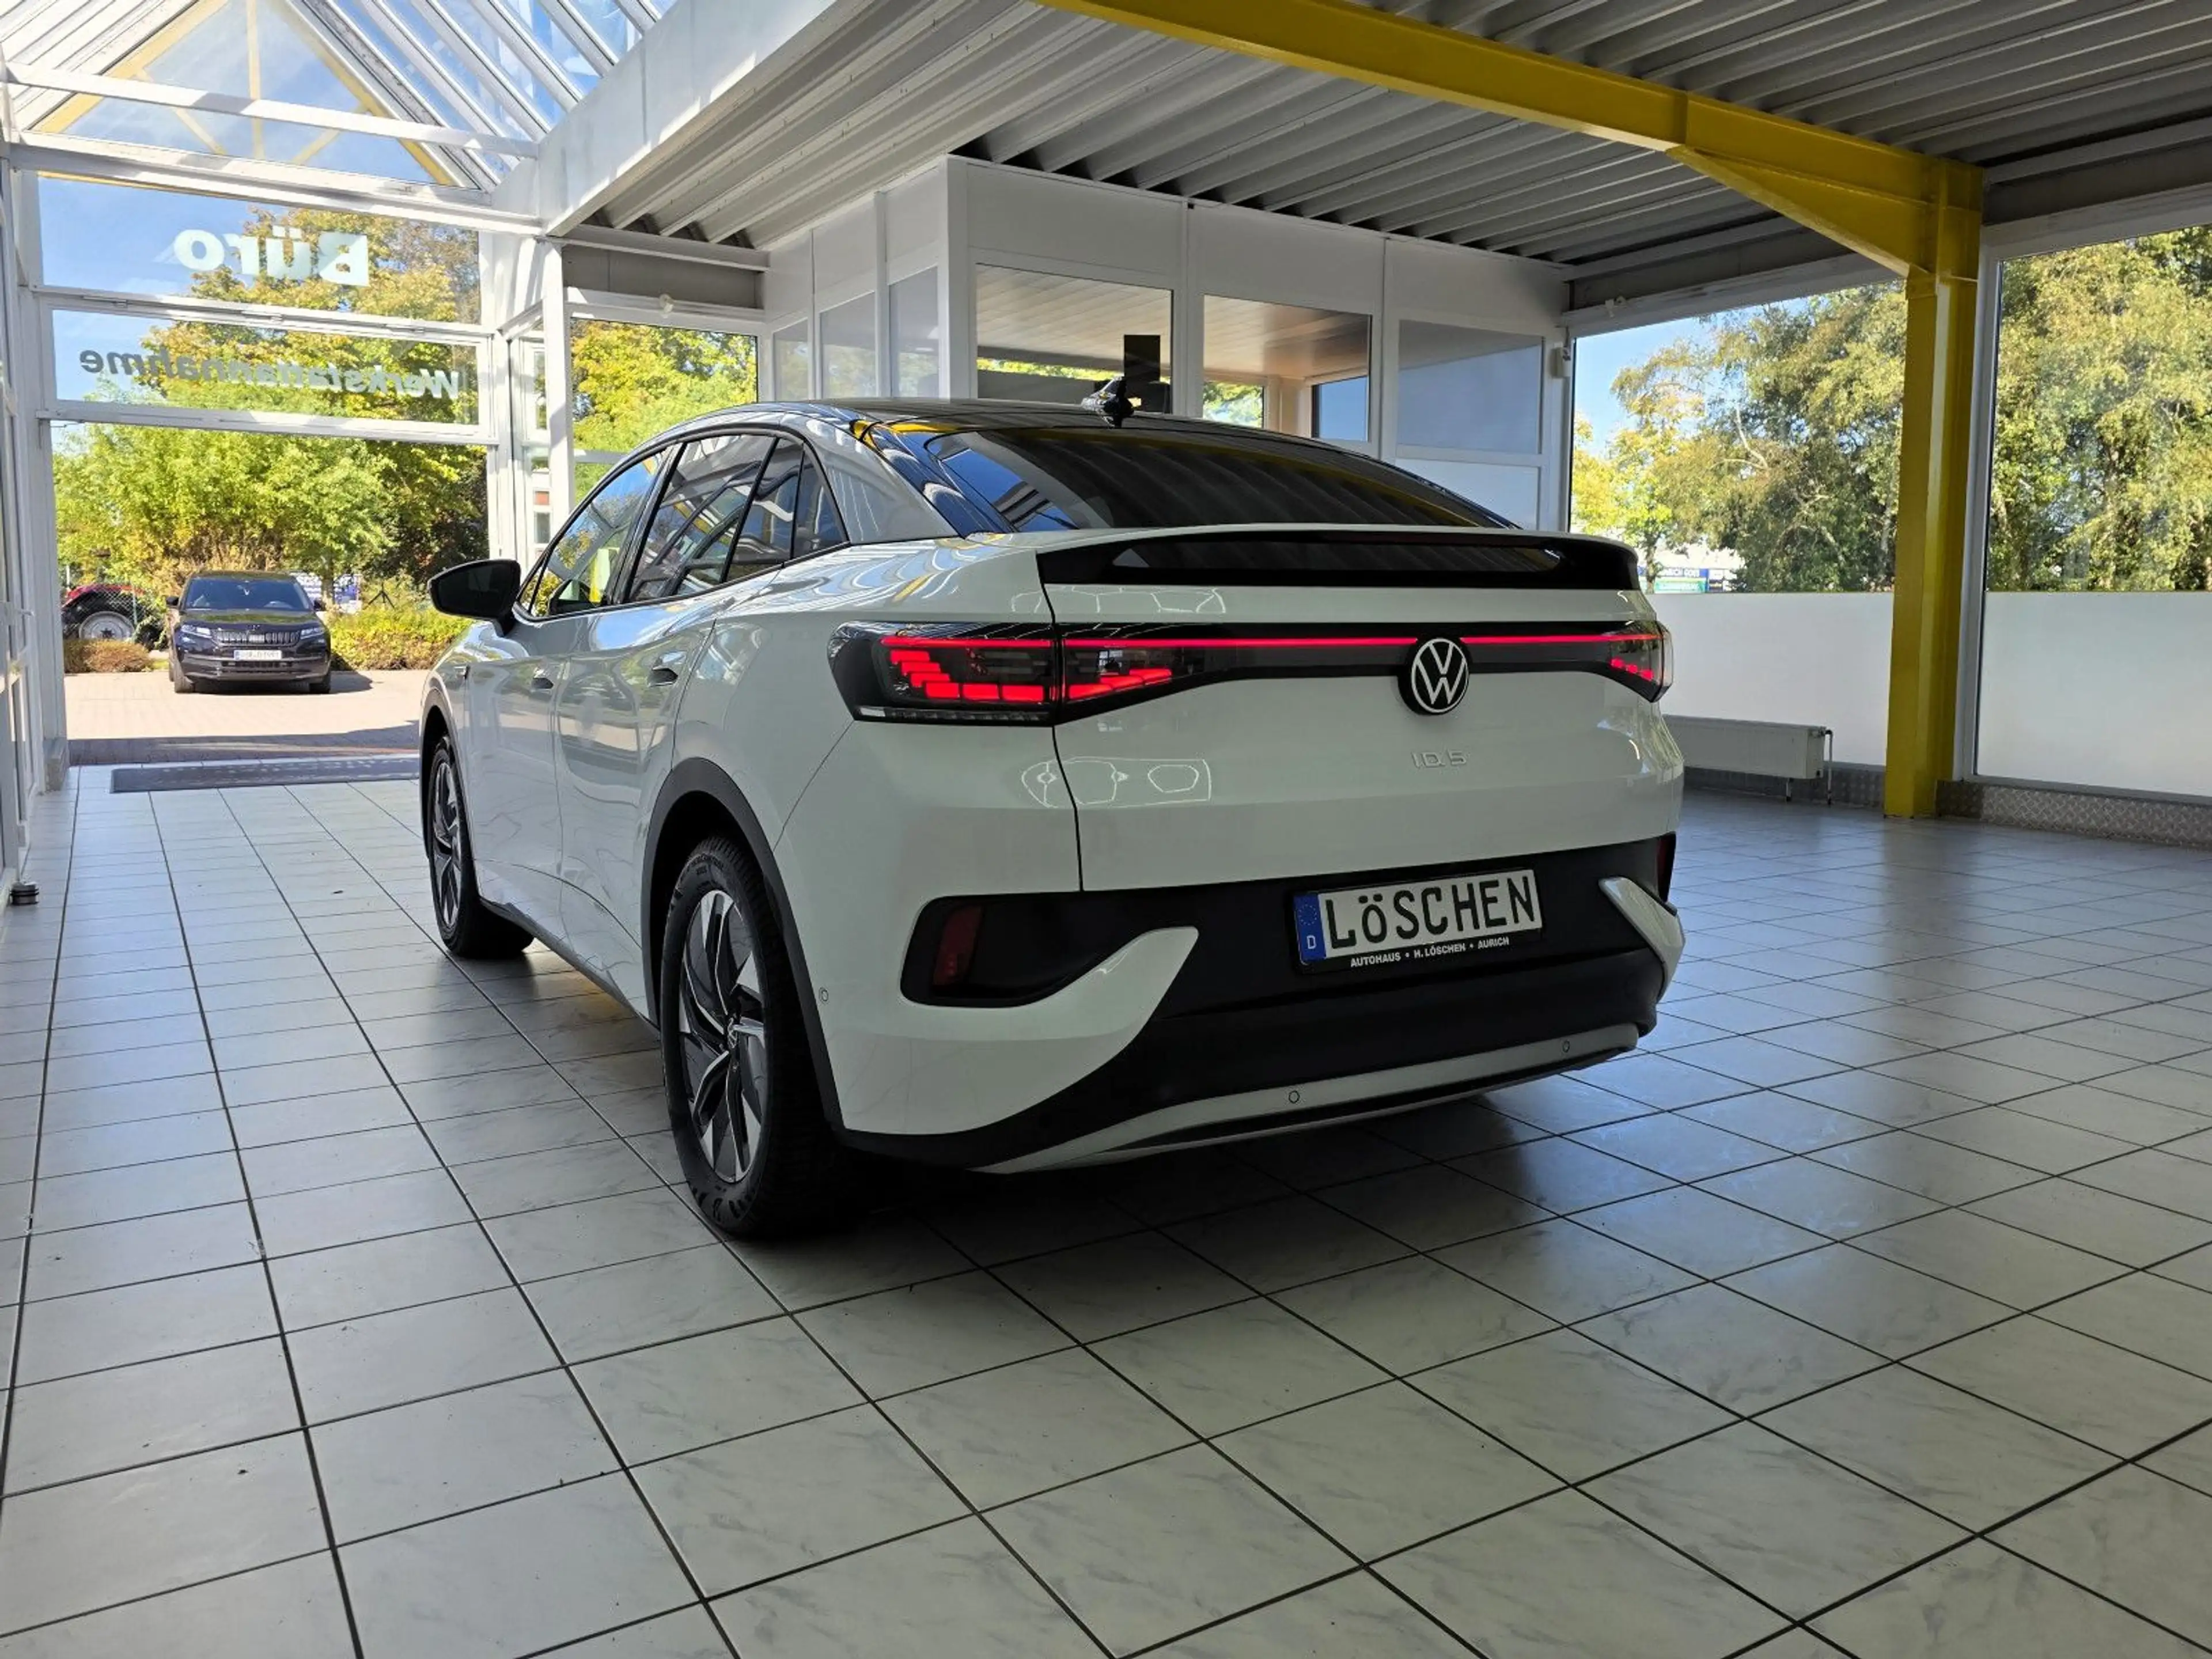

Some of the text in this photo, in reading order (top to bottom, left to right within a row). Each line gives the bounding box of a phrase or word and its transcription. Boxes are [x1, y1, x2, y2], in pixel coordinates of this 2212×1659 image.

[1306, 875, 1536, 950] D LÖSCHEN
[1350, 952, 1402, 968] AUTOHAUS
[1478, 937, 1510, 949] AURICH
